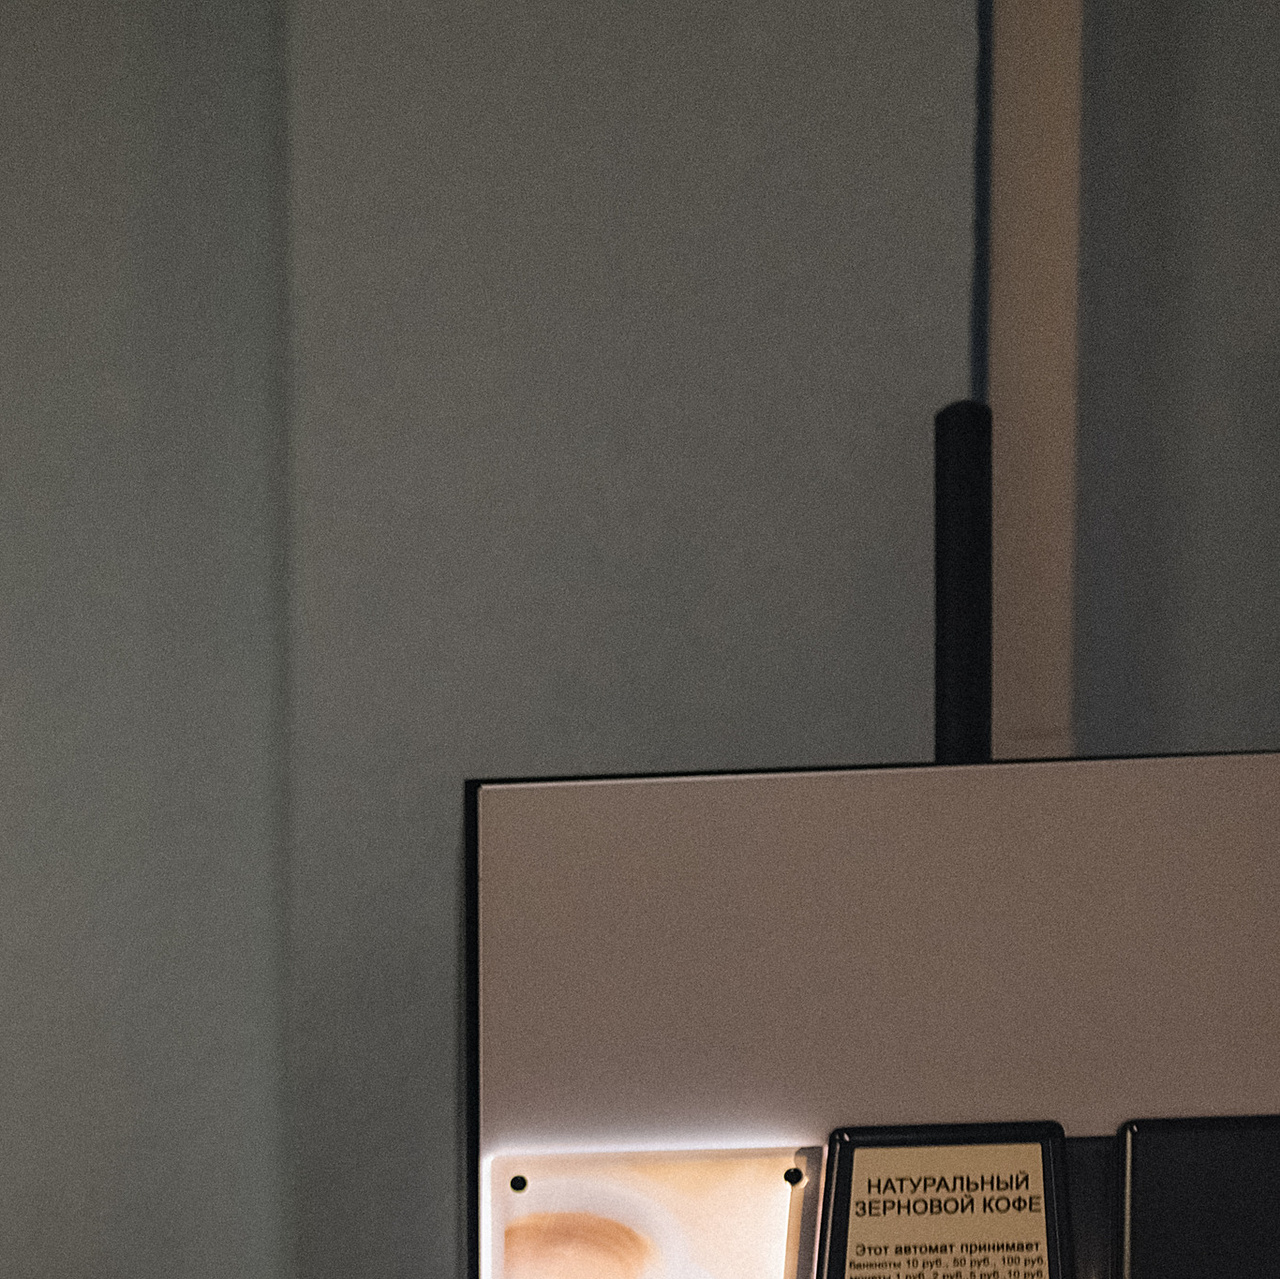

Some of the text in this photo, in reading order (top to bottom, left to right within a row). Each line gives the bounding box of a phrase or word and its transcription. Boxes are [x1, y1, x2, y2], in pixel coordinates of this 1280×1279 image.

[867, 1170, 1029, 1195] НАТУРАЛЬНЫЙ
[855, 1194, 1042, 1217] ЗЕРНОВОЙ КОФЕ
[856, 1242, 1040, 1257] Этот автомат принимает
[907, 1258, 919, 1269] 10
[1002, 1256, 1020, 1267] 100
